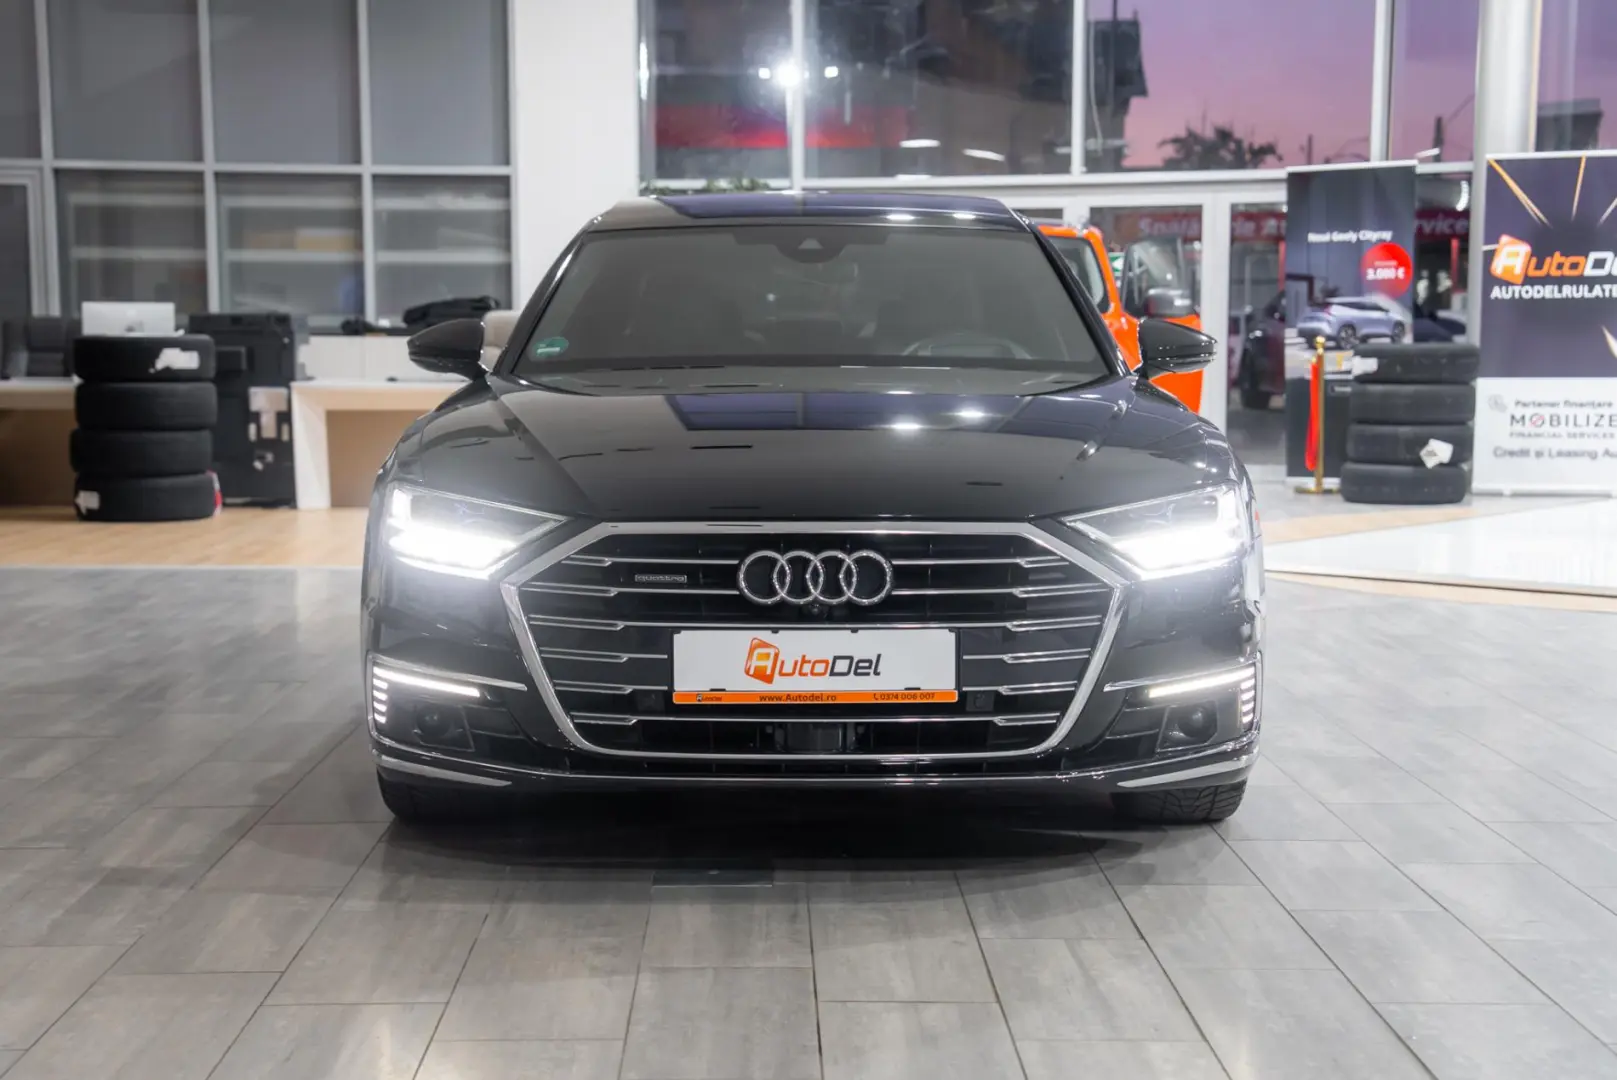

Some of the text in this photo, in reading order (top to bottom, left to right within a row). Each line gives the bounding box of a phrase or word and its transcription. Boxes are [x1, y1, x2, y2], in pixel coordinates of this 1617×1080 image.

[1412, 211, 1469, 235] rvice
[1515, 399, 1560, 409] Partener
[1509, 412, 1617, 428] MOBILIZE
[1509, 431, 1615, 439] FINANCIAL SERVICES
[1493, 446, 1531, 458] Credit
[1548, 447, 1598, 460] Leasing
[744, 637, 882, 685] AutoDel
[758, 693, 837, 703] www.Autodel.ro
[880, 692, 936, 701] 0374 006 007
